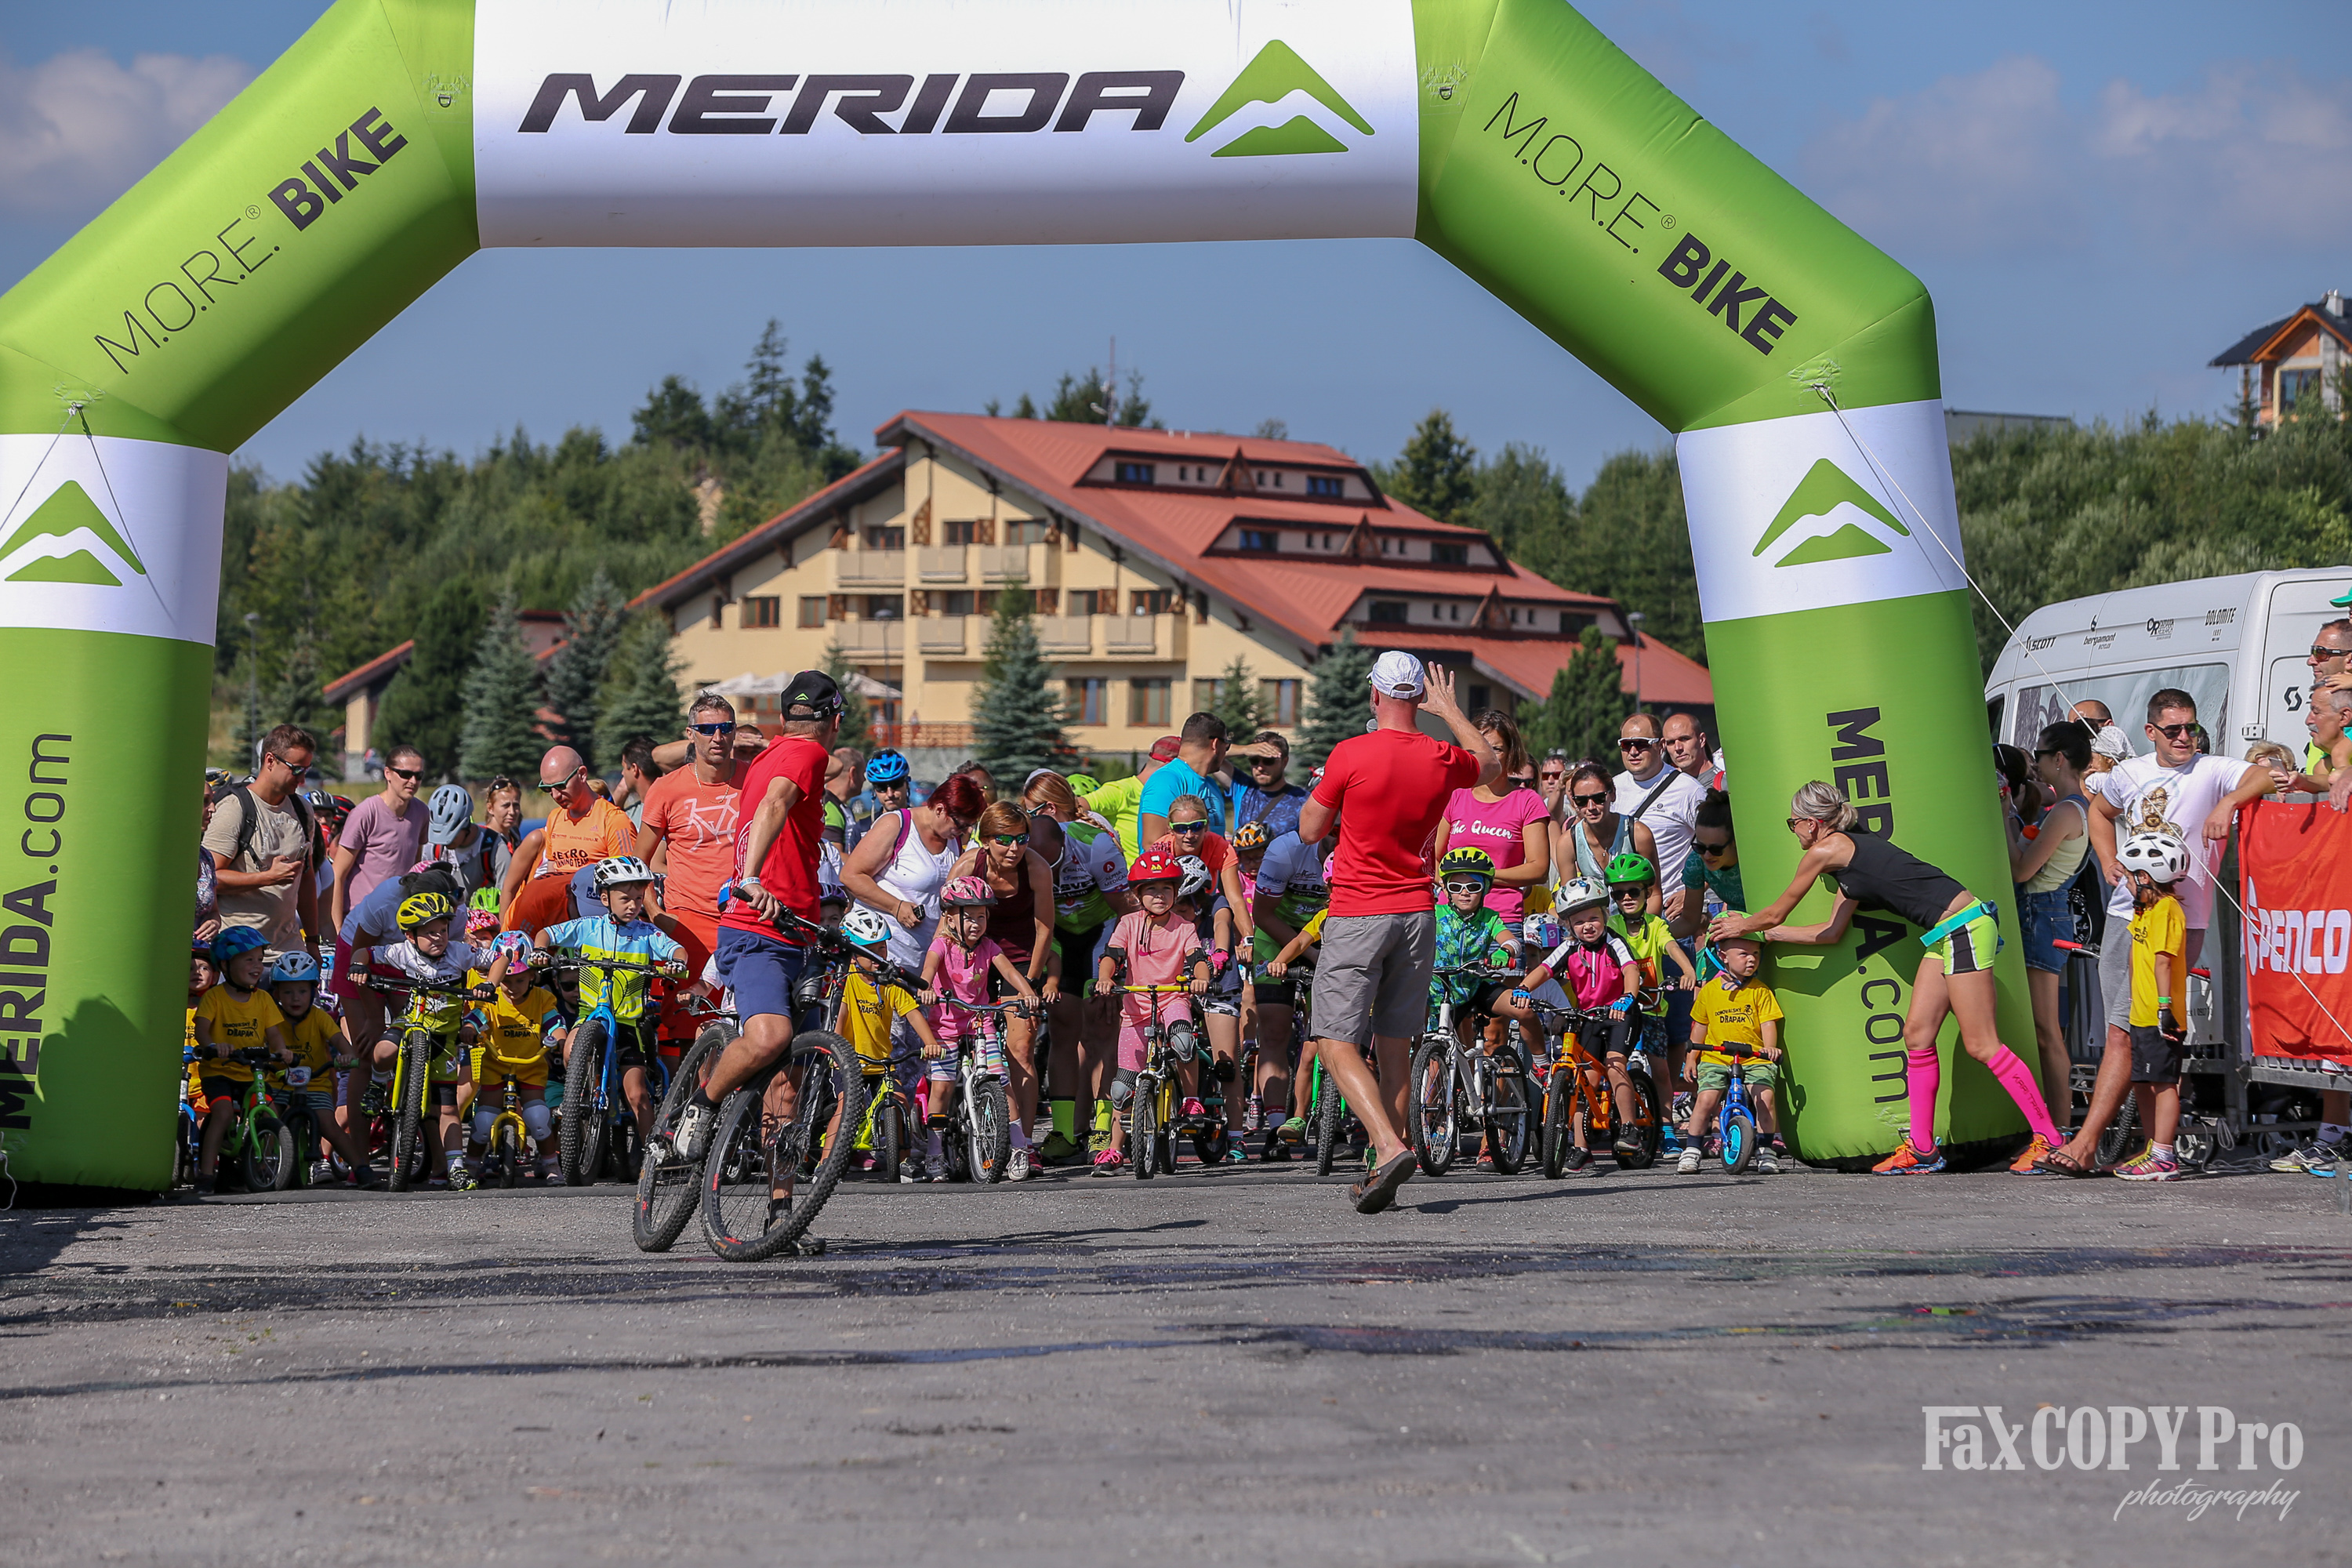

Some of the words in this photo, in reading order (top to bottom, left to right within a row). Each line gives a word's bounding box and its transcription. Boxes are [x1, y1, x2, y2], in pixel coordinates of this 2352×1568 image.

[518, 71, 1185, 134] MERIDA
[267, 105, 408, 232] BIKE
[1657, 232, 1798, 356] BIKE
[2030, 637, 2056, 652] SCOTT
[2083, 633, 2116, 646] bergamont
[1471, 819, 1513, 840] Queen
[553, 848, 588, 861] RETRO
